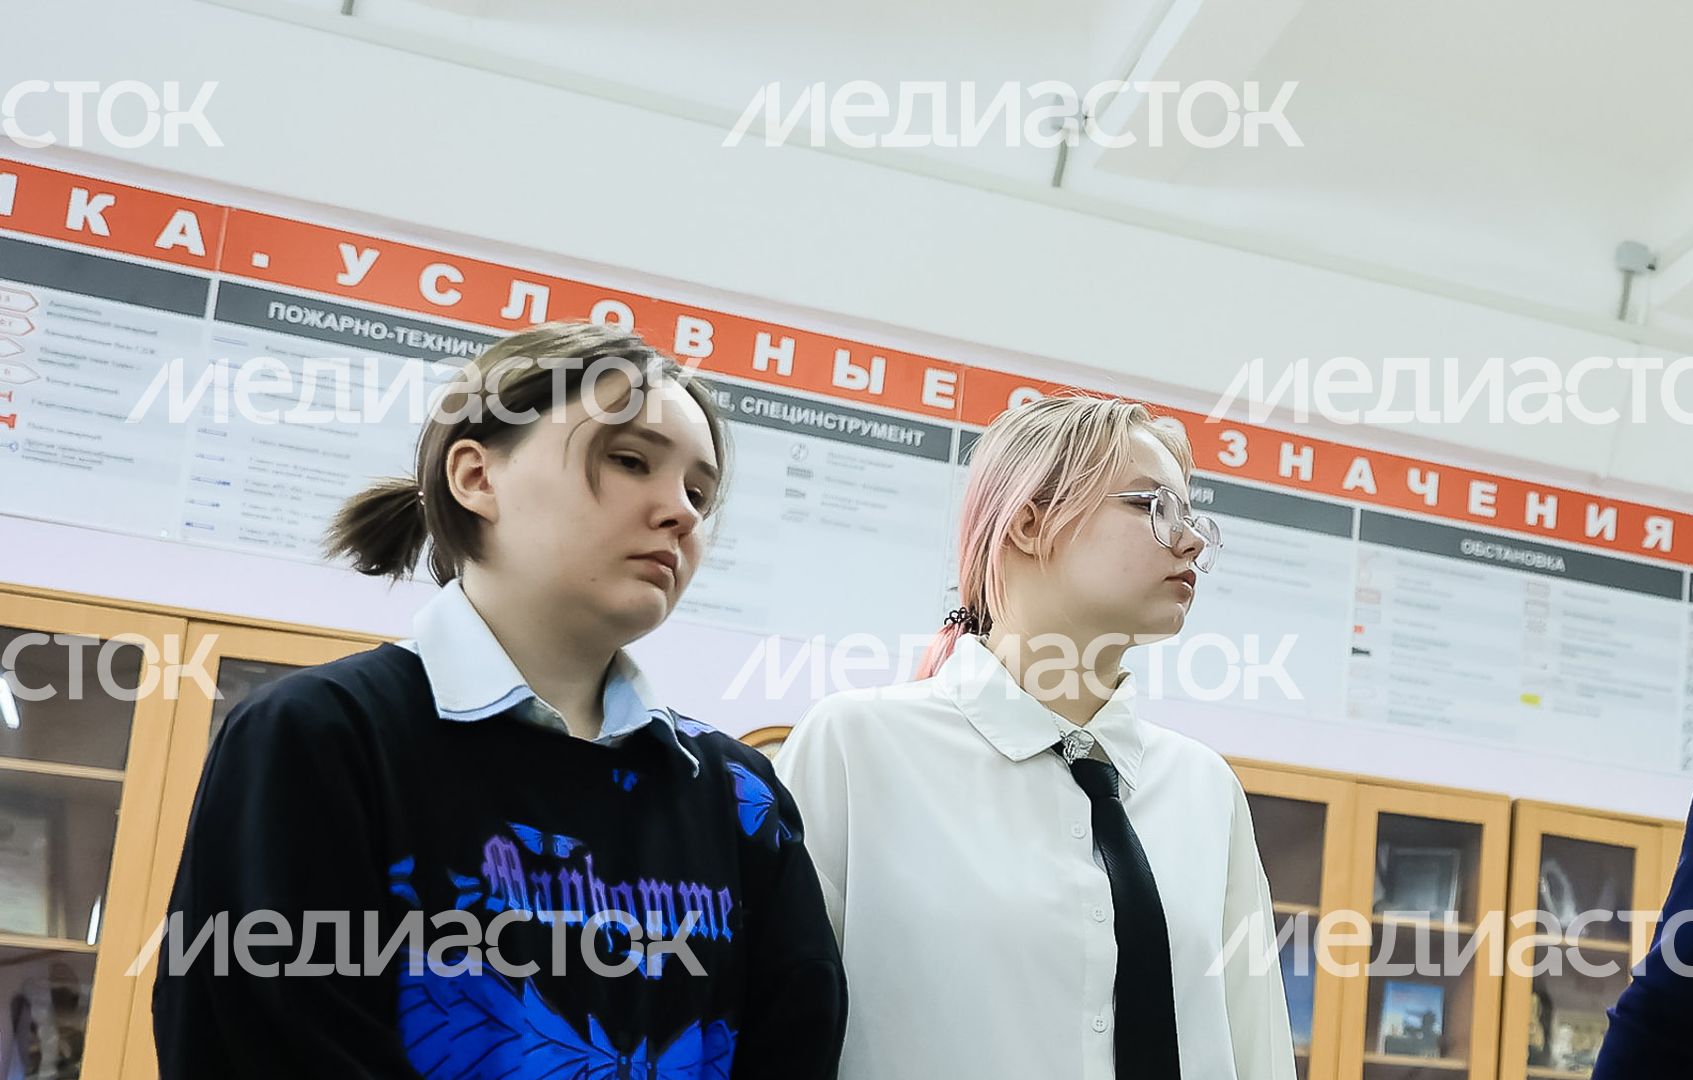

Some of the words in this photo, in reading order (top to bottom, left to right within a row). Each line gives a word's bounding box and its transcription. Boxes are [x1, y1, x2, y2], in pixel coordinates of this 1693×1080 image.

[335, 242, 959, 410] УСЛОВНЫЕ
[1008, 385, 1675, 553] ЗНАЧЕНИЯ
[740, 396, 926, 447] СПЕЦИНСТРУМЕНТ
[1460, 539, 1566, 573] ОБСТАНОВКА
